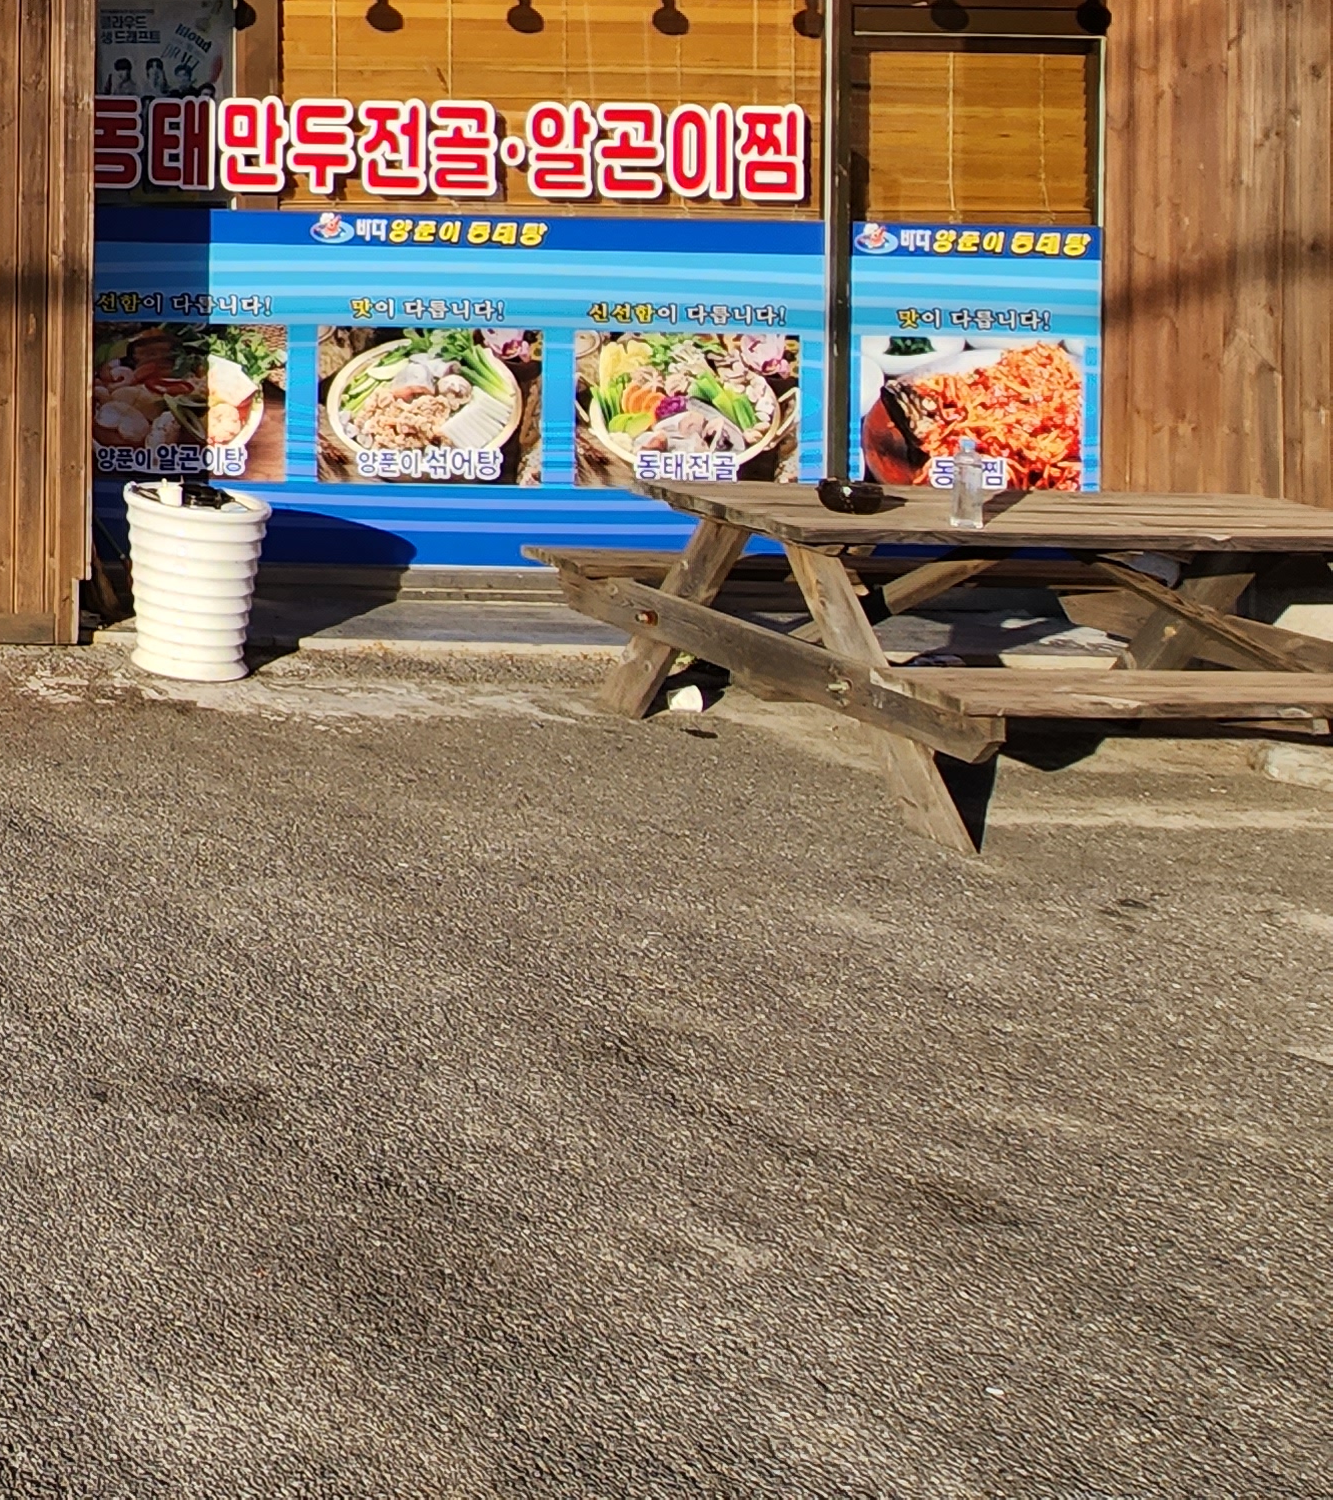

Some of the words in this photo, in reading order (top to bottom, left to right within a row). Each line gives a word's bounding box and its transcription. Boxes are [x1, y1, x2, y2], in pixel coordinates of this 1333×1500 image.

[467, 221, 548, 246] 동태탕
[1010, 230, 1092, 256] 동태탕
[93, 292, 163, 315] 선함이
[171, 293, 273, 316] 다릅니다!
[351, 299, 395, 320] 맛이
[402, 300, 506, 322] 다릅니다!
[588, 303, 677, 326] 신선함이
[685, 304, 787, 327] 다릅니다!
[898, 308, 942, 330] 맛이
[949, 309, 1051, 332] 다릅니다!
[635, 451, 738, 482] 동태전골
[929, 455, 1007, 490] 동찜
